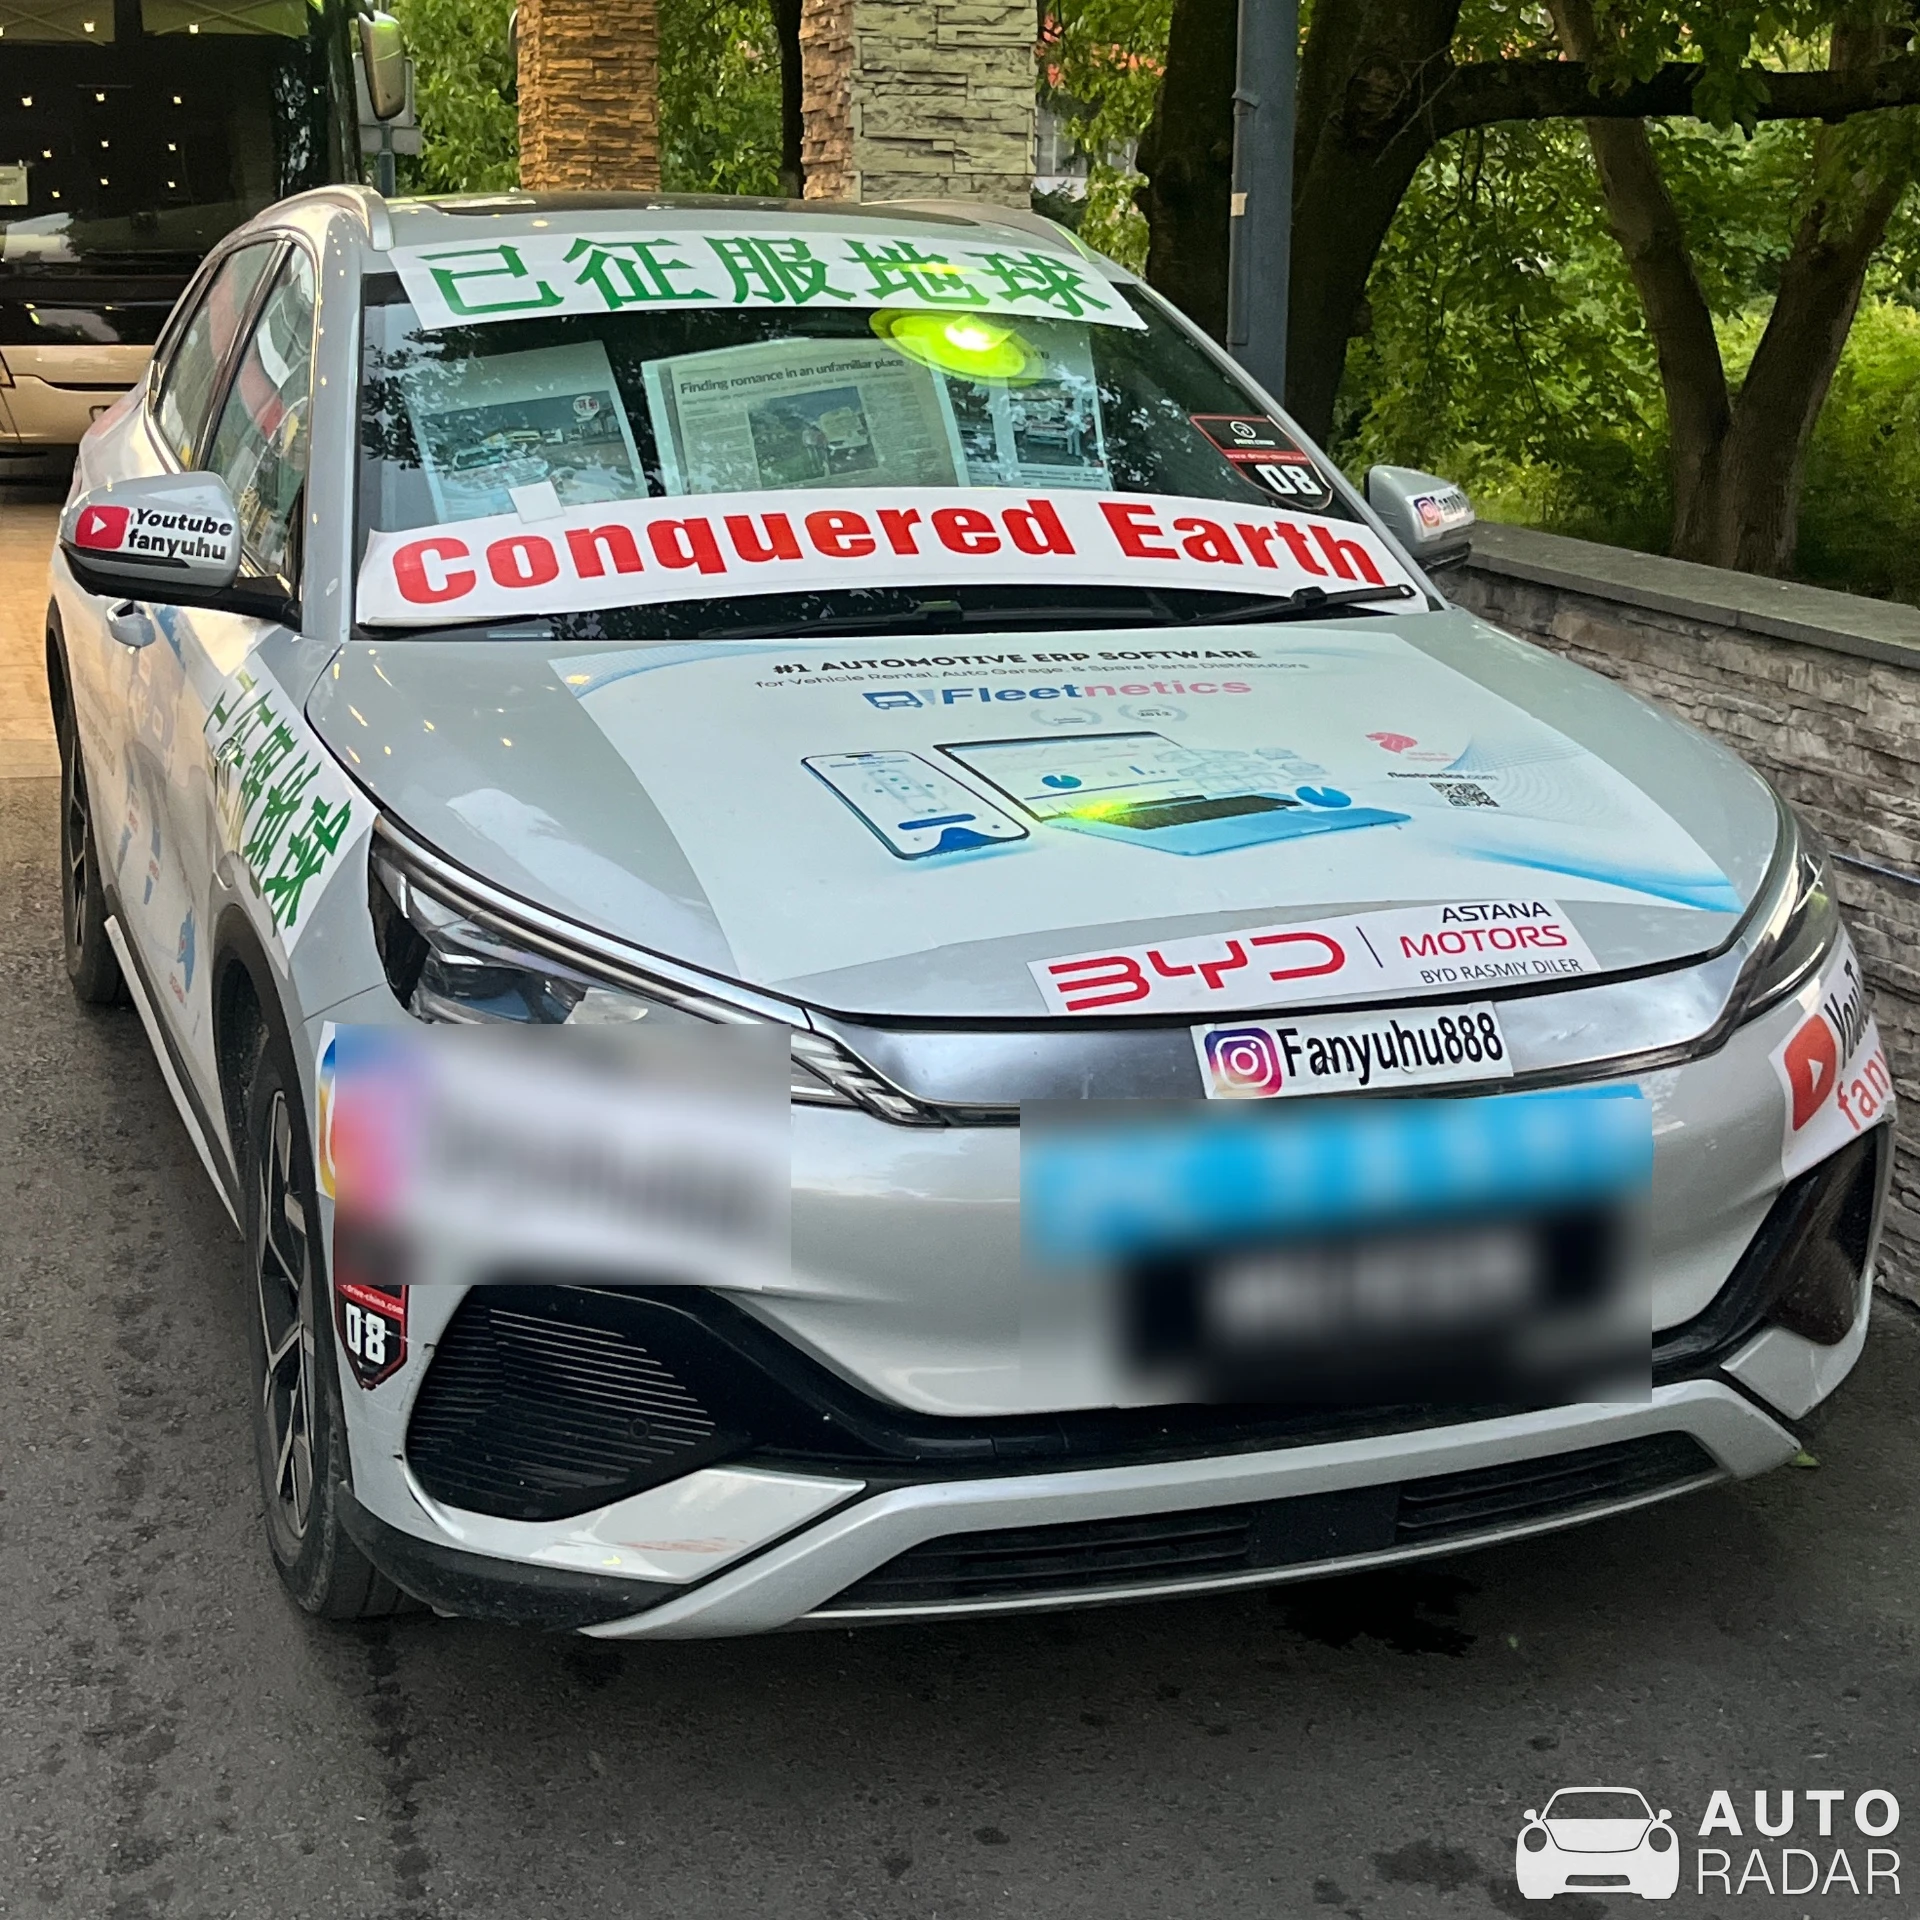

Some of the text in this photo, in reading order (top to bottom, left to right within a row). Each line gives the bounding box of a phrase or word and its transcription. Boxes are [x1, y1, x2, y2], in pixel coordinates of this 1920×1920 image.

[680, 378, 729, 394] Finding
[731, 371, 784, 388] romance
[785, 367, 798, 379] in
[799, 366, 815, 378] an
[816, 359, 872, 374] unfamiliar
[1255, 464, 1322, 495] 08
[137, 508, 233, 536] Youtube
[128, 528, 226, 560] fanyuhu
[392, 499, 1386, 604] Conquered Earth
[754, 680, 785, 688] for
[787, 674, 865, 686] Vehicle
[942, 669, 989, 678] Auto
[1072, 665, 1086, 673] &
[1088, 664, 1145, 673] Spare
[1149, 663, 1196, 671] Parts
[773, 650, 1262, 675] #1 AUTOMOTIVE ERP SOFTWARE
[941, 680, 1252, 705] Fleetnetics
[1441, 901, 1552, 924] ASTANA
[1400, 924, 1568, 959] MOTORS
[1048, 931, 1346, 1012] BYD
[1420, 957, 1583, 985] BYD RASMIY DILER
[1281, 1012, 1503, 1086] Fanyuhu888
[346, 1302, 385, 1365] 08
